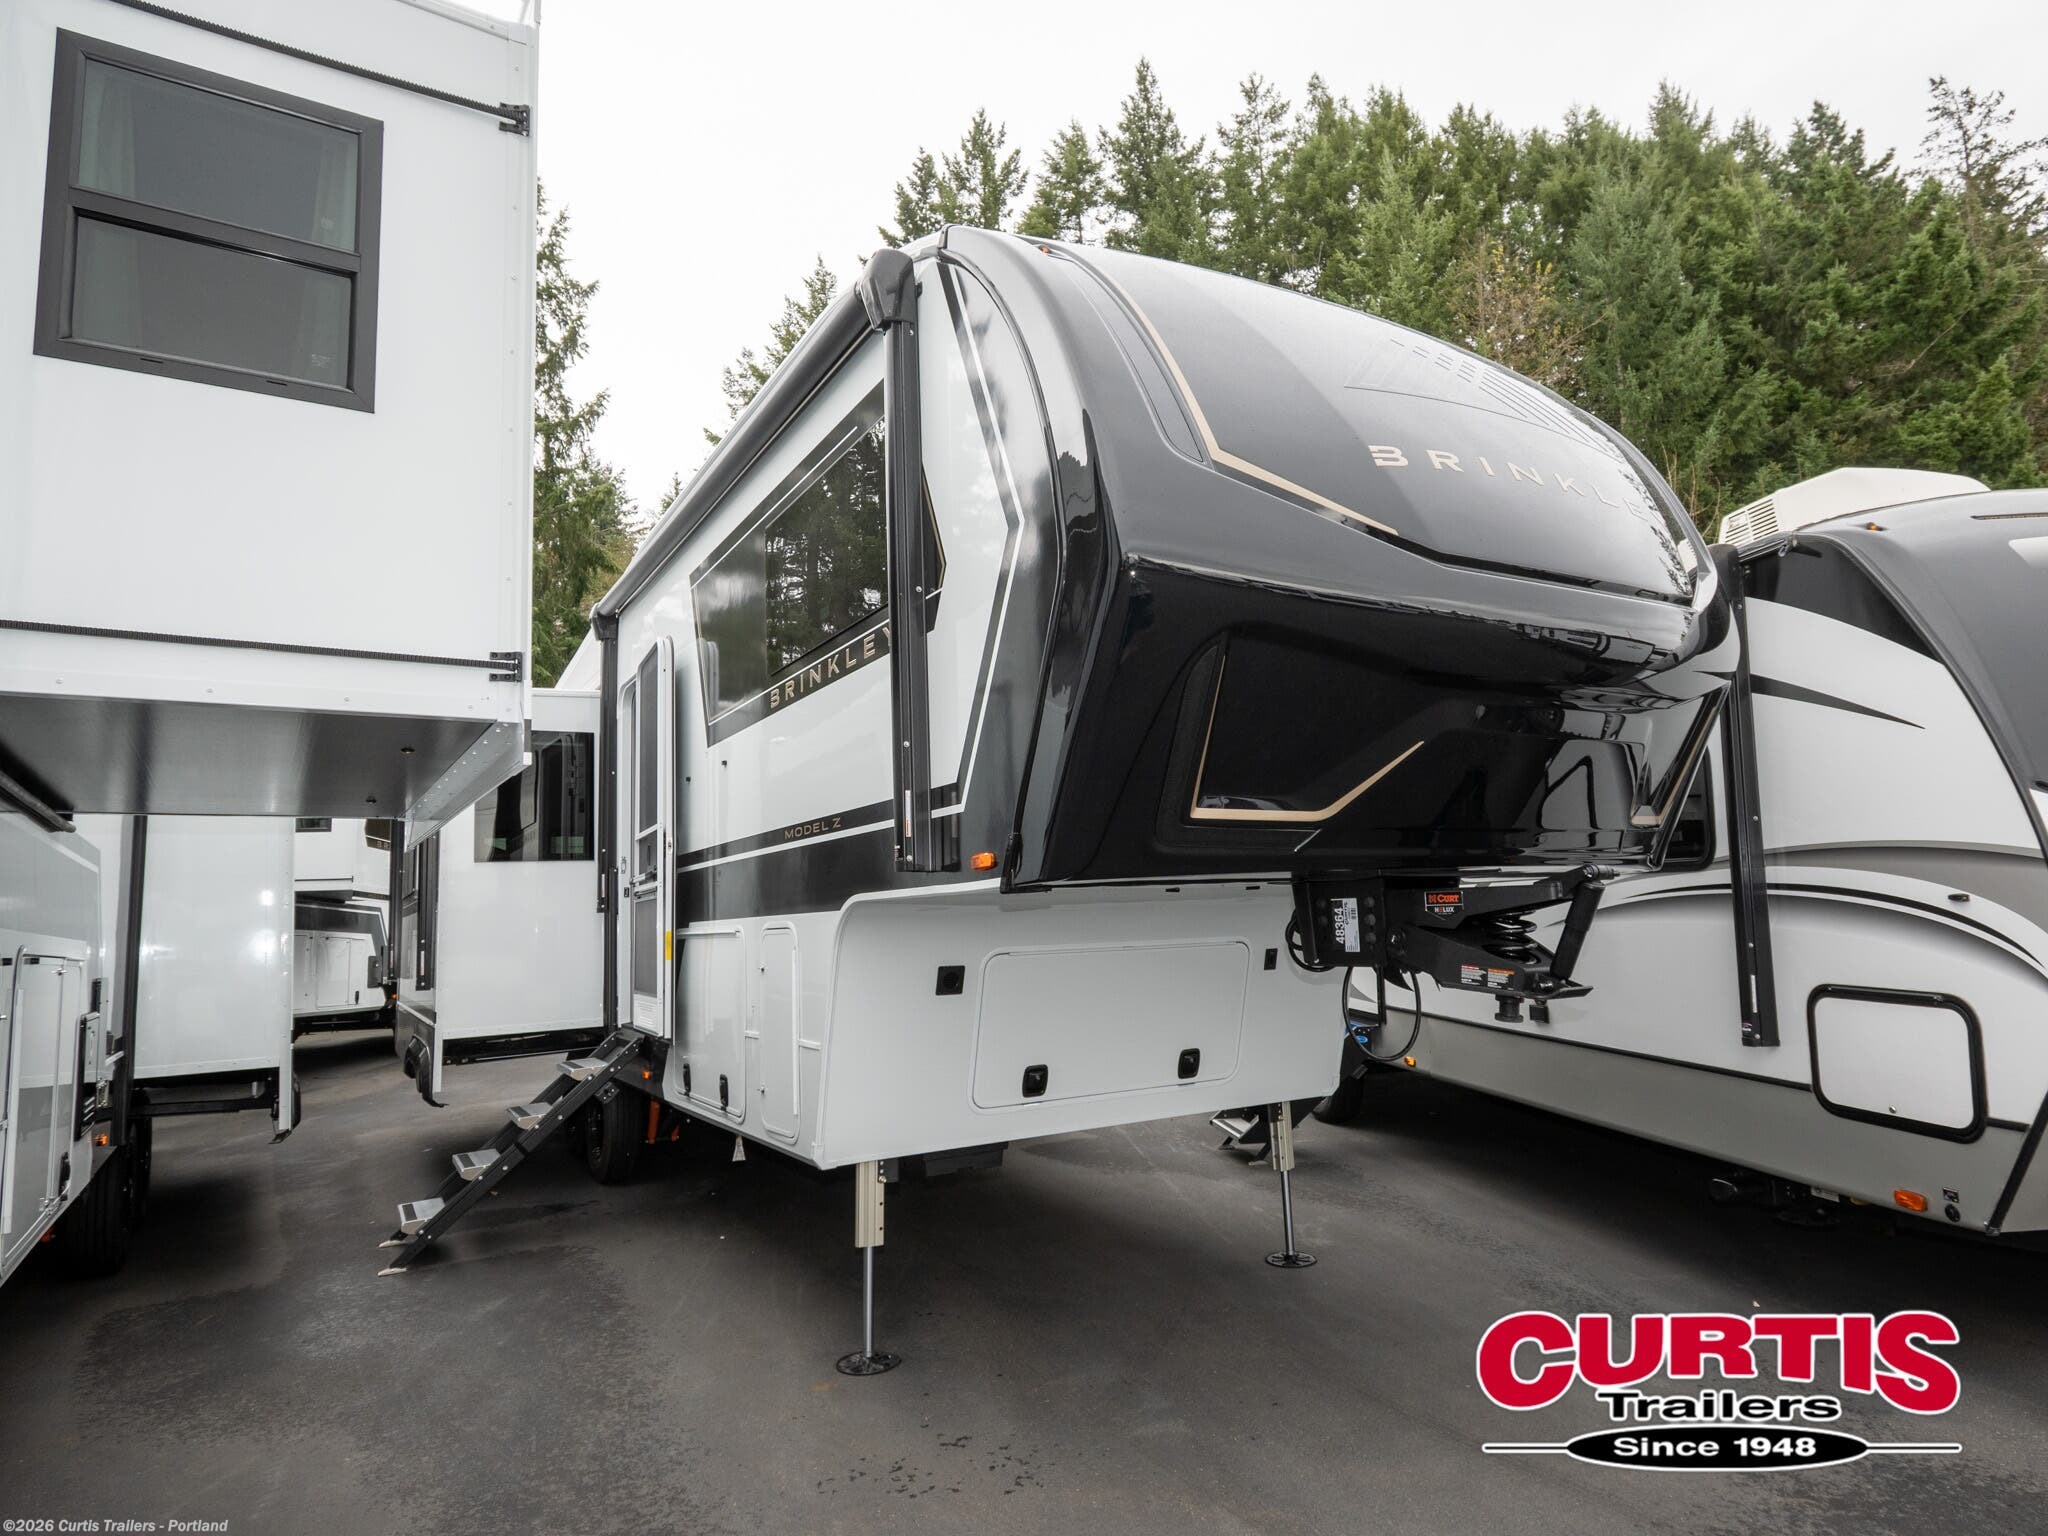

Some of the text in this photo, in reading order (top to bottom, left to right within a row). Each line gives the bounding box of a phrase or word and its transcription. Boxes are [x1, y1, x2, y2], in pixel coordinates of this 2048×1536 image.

[1367, 444, 1663, 526] BRINKLE
[784, 816, 842, 841] MODEL Z
[1437, 894, 1460, 903] CURT
[1334, 907, 1346, 945] 48364
